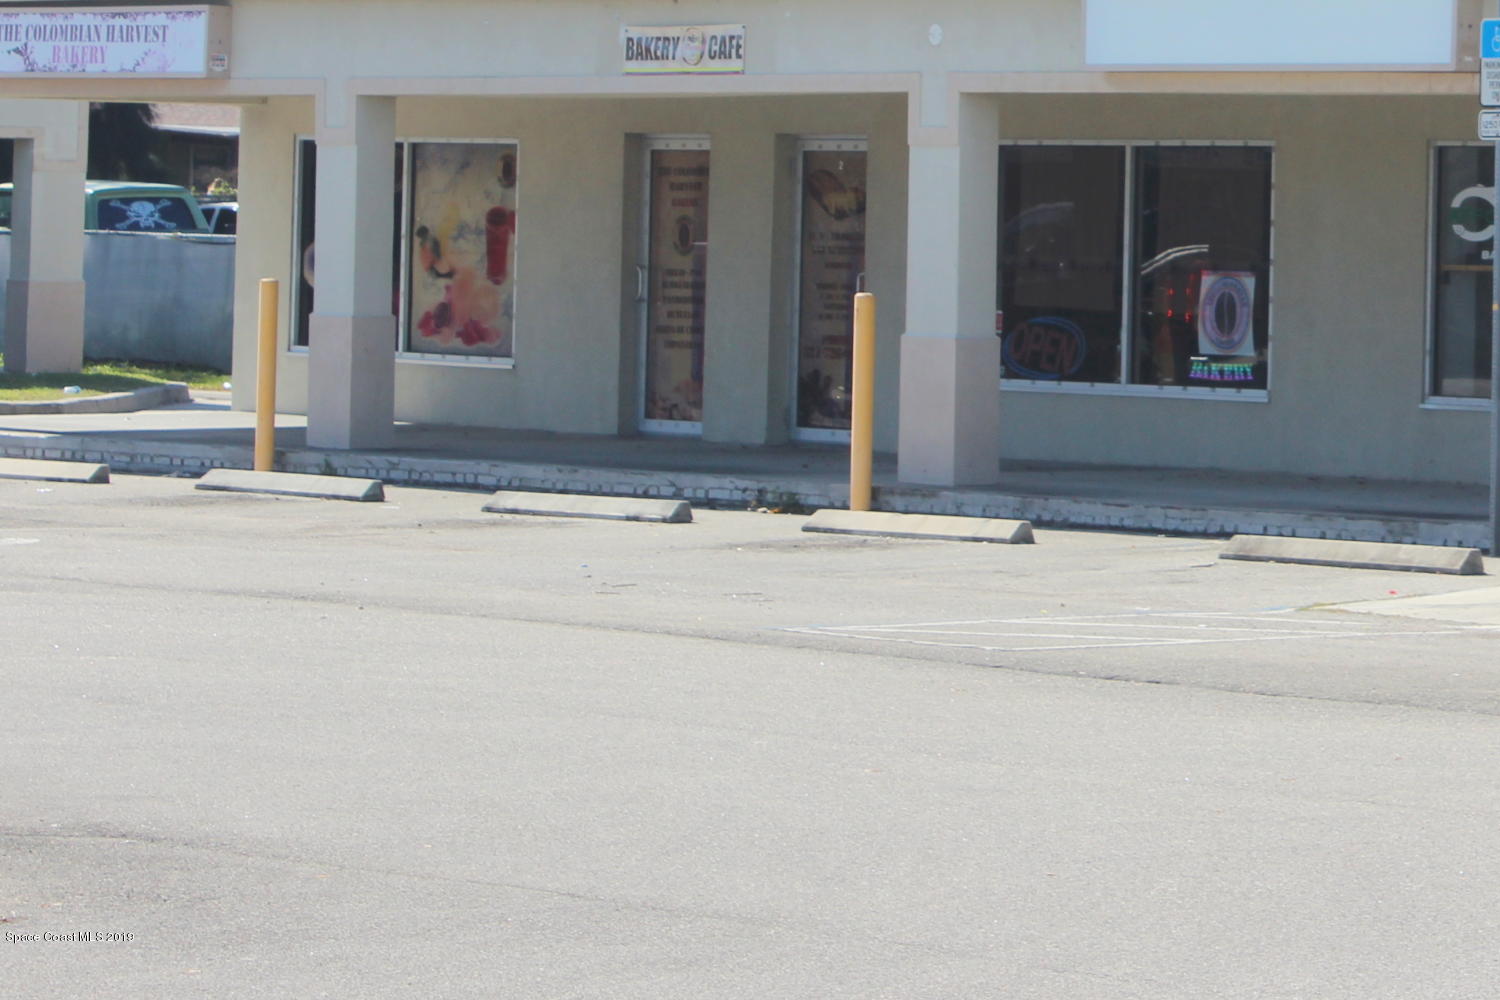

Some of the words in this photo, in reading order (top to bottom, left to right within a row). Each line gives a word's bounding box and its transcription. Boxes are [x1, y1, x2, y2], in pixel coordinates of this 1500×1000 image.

[0, 24, 21, 42] THE
[25, 23, 102, 43] COLOMBIAN
[105, 23, 170, 43] HARVEST
[52, 44, 107, 65] BAKERY
[625, 36, 680, 61] BAKERY
[708, 34, 743, 60] CAFE
[1009, 321, 1079, 378] OPEN
